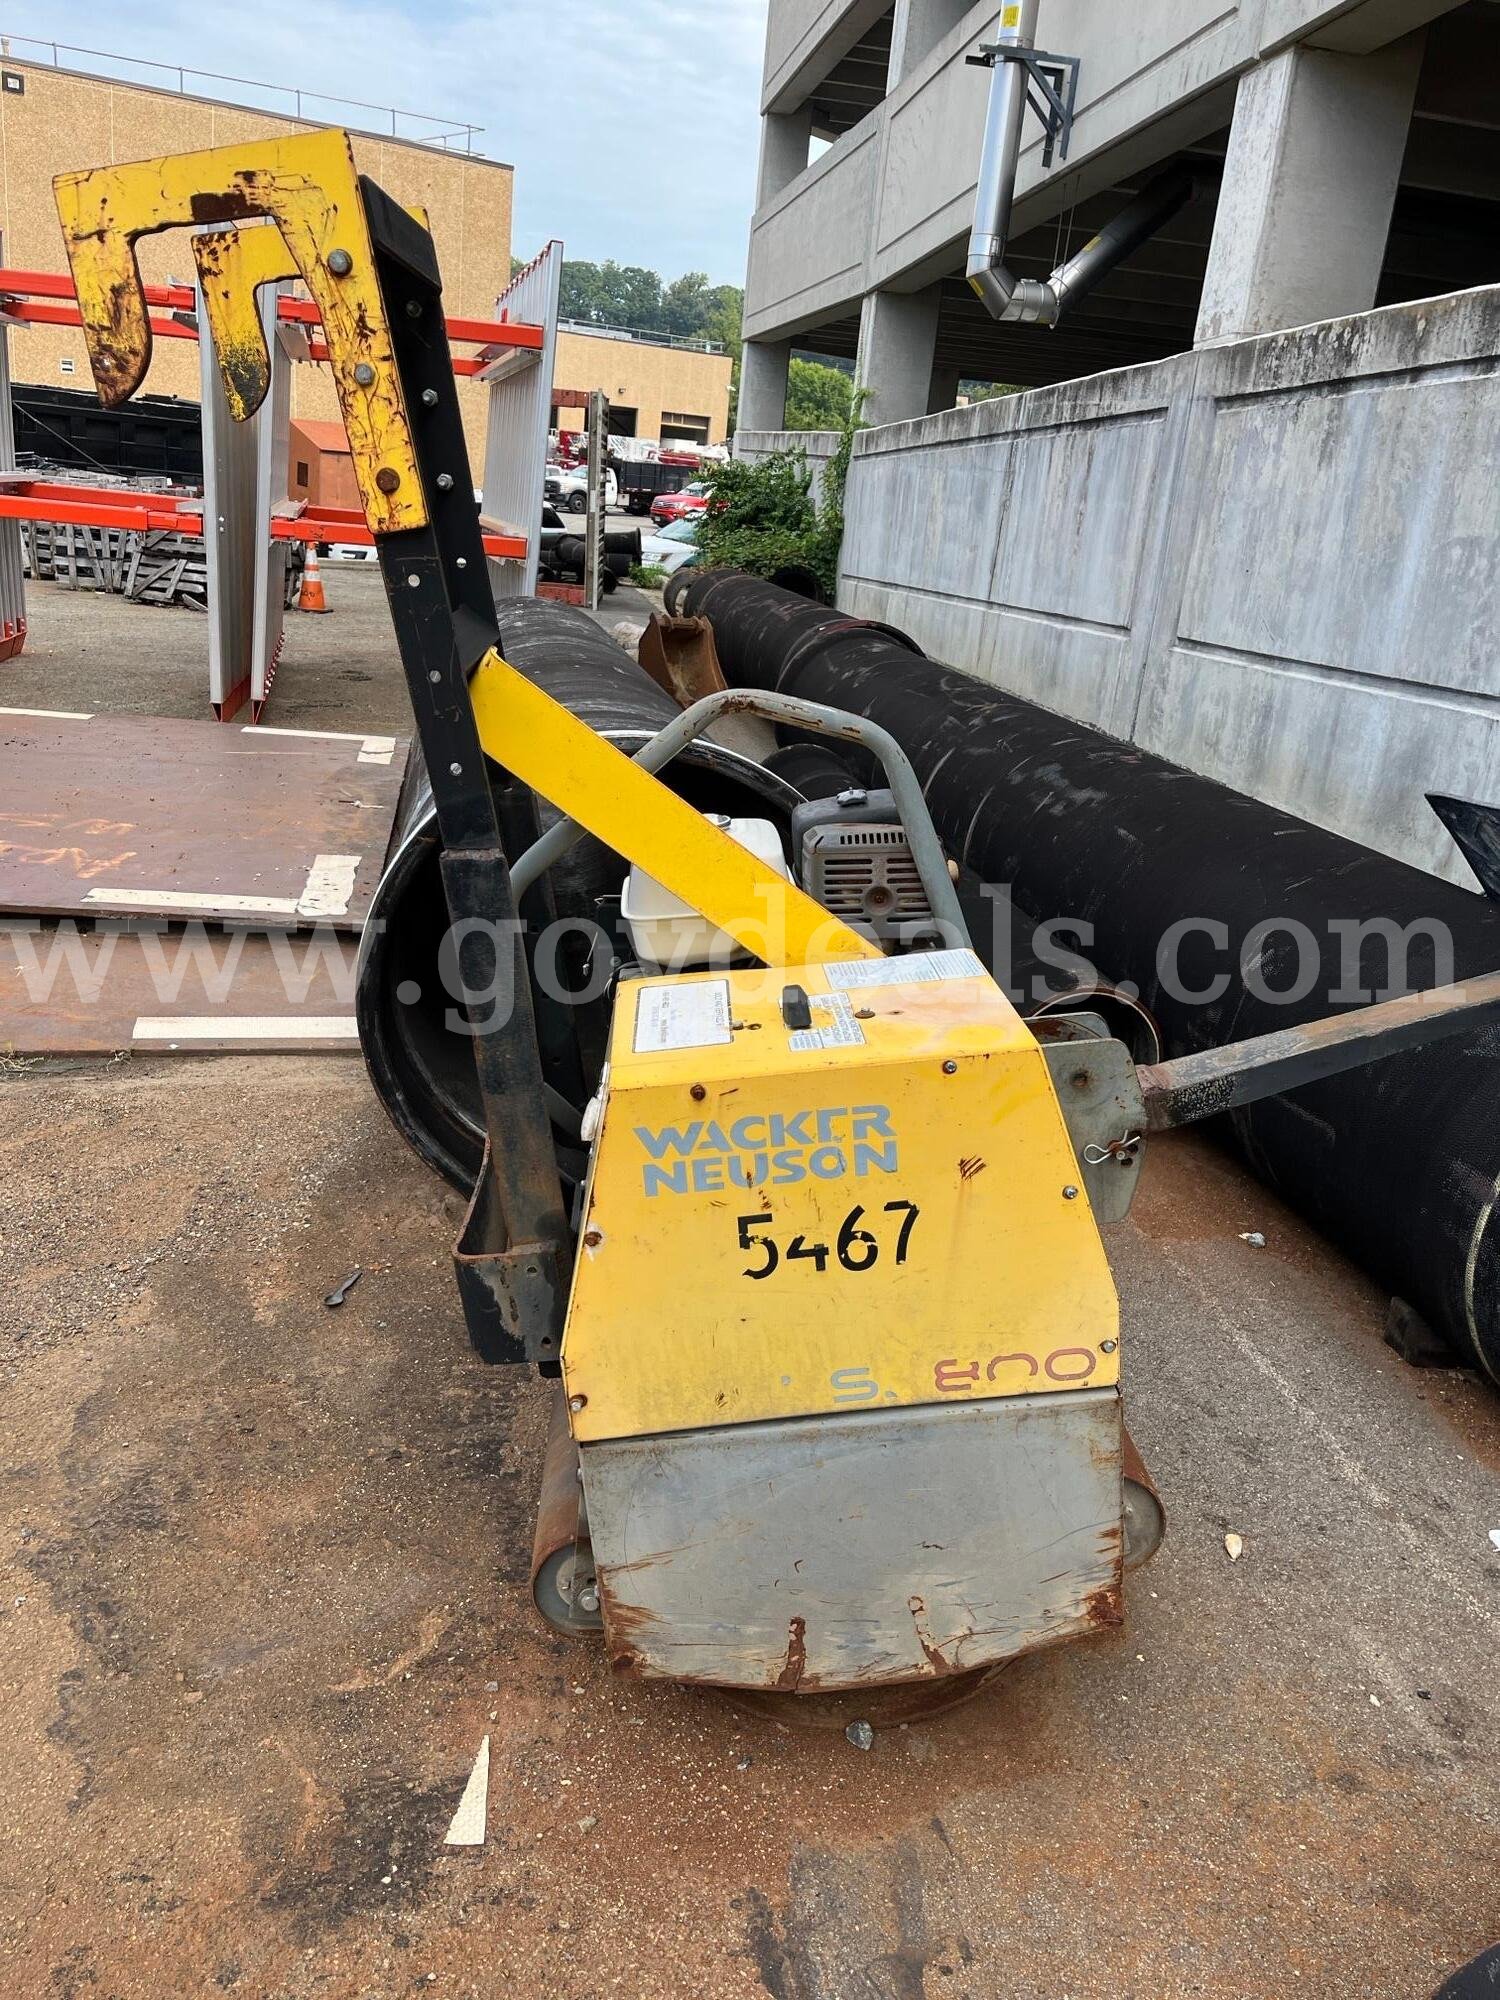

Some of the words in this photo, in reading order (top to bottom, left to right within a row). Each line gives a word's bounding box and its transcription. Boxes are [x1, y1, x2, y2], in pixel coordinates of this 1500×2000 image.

[631, 1104, 898, 1160] WACKER
[642, 1140, 899, 1197] NEUSON
[737, 1200, 920, 1280] 5467
